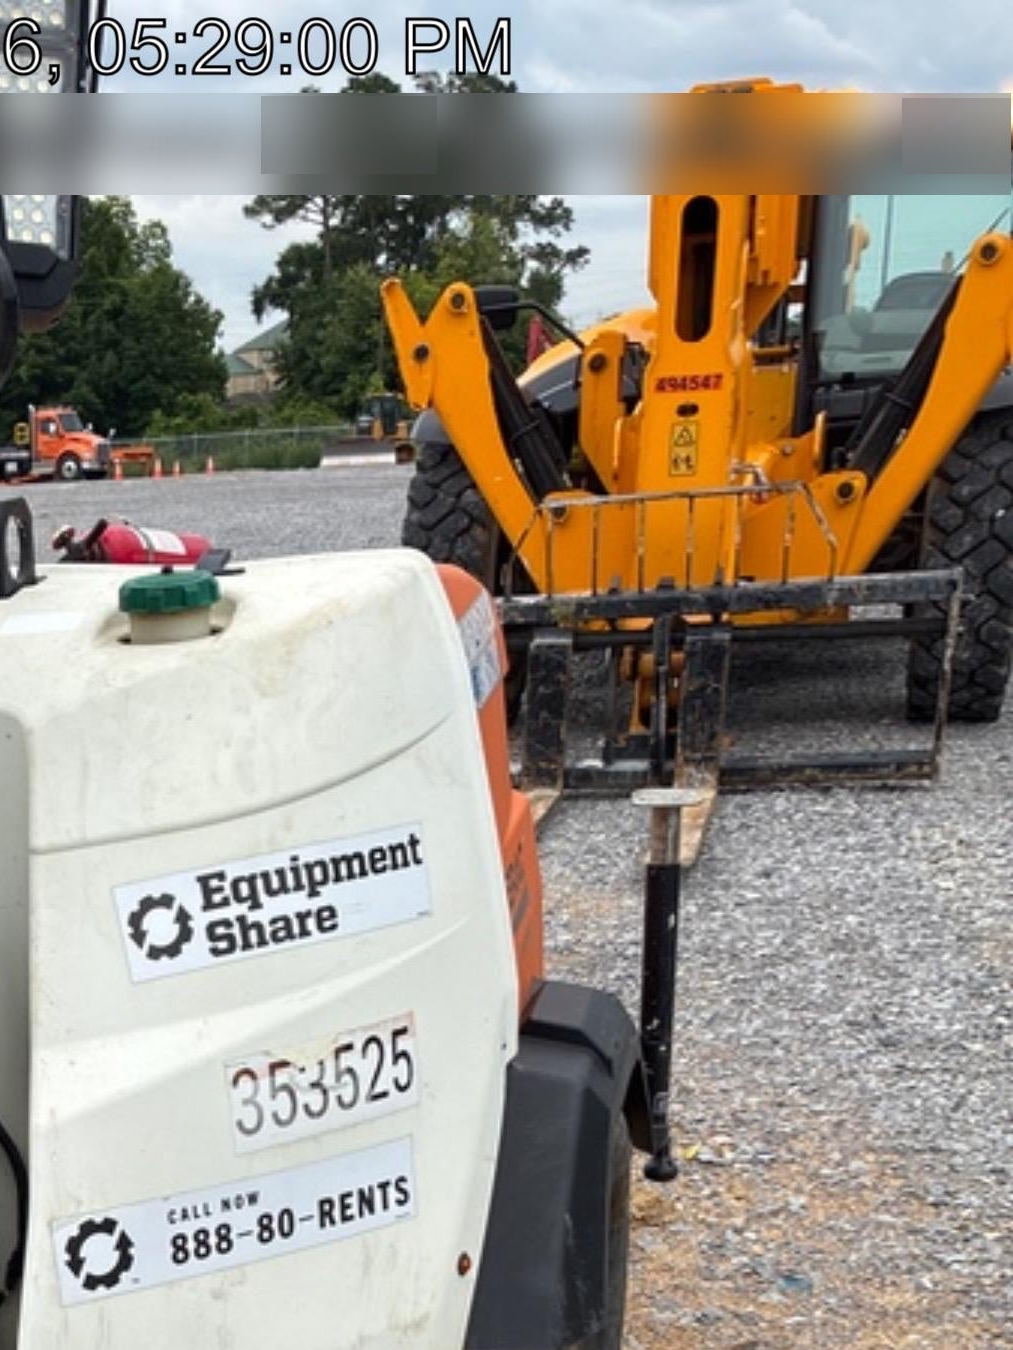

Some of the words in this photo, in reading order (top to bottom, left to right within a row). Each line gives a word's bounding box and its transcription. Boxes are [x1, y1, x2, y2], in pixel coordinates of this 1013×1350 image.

[656, 372, 723, 393] 494547
[196, 833, 423, 912] Equipment
[205, 904, 339, 957] Share
[232, 1025, 415, 1136] 353525
[167, 1202, 212, 1224] CALL
[220, 1191, 260, 1212] NOW
[170, 1175, 411, 1265] 888-80-RENTS
